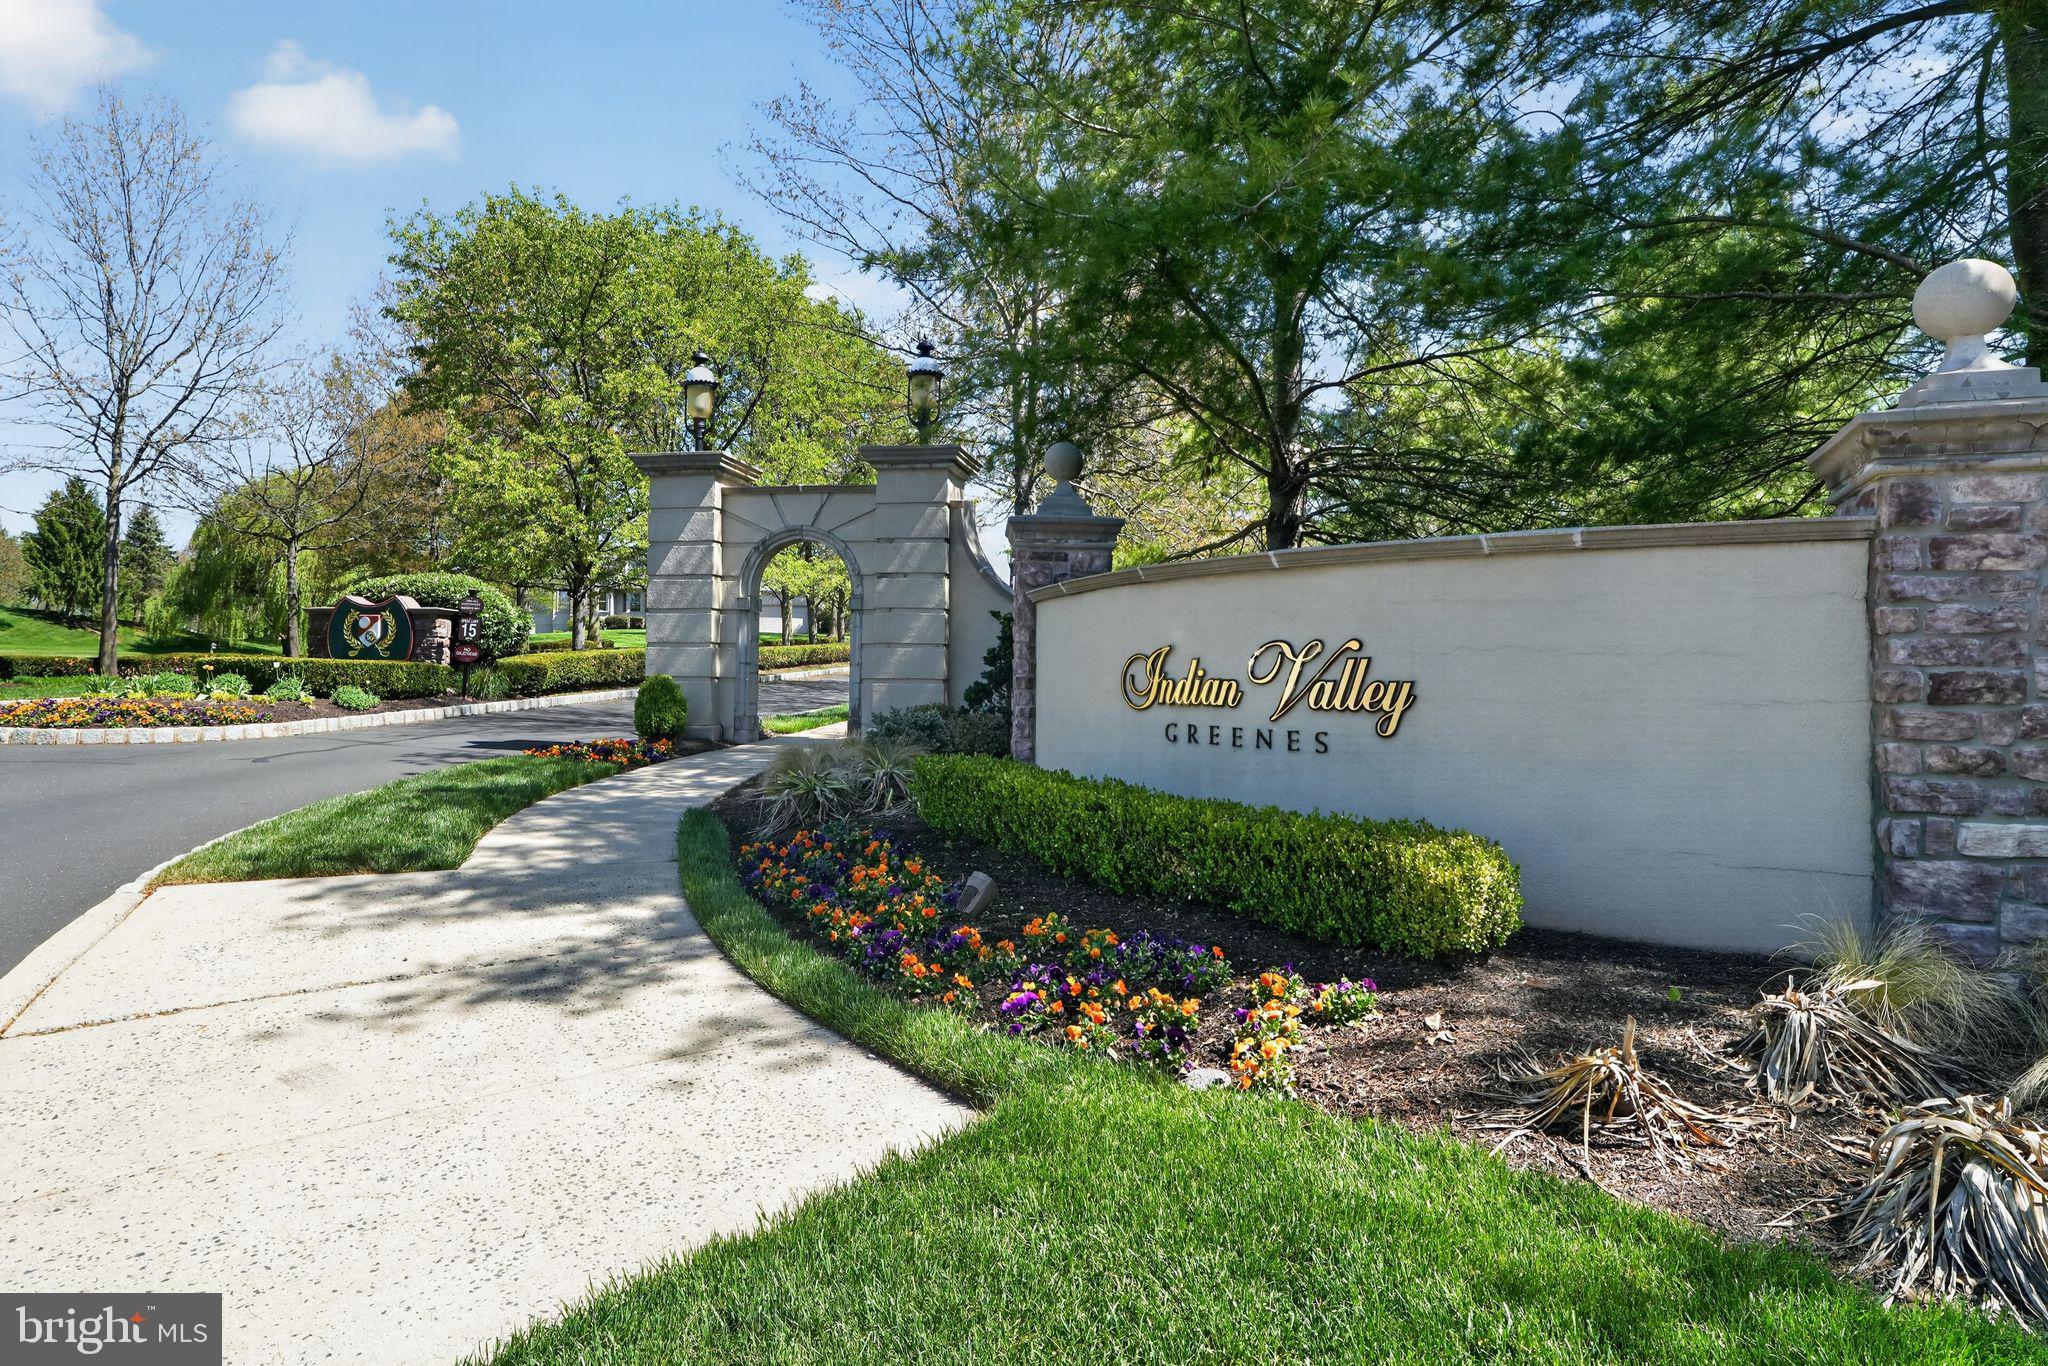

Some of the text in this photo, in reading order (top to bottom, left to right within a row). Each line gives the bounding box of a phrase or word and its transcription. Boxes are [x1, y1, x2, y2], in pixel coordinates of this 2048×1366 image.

[461, 623, 477, 637] 15
[1121, 638, 1417, 738] Indian Valley
[1165, 723, 1329, 754] GREENES
